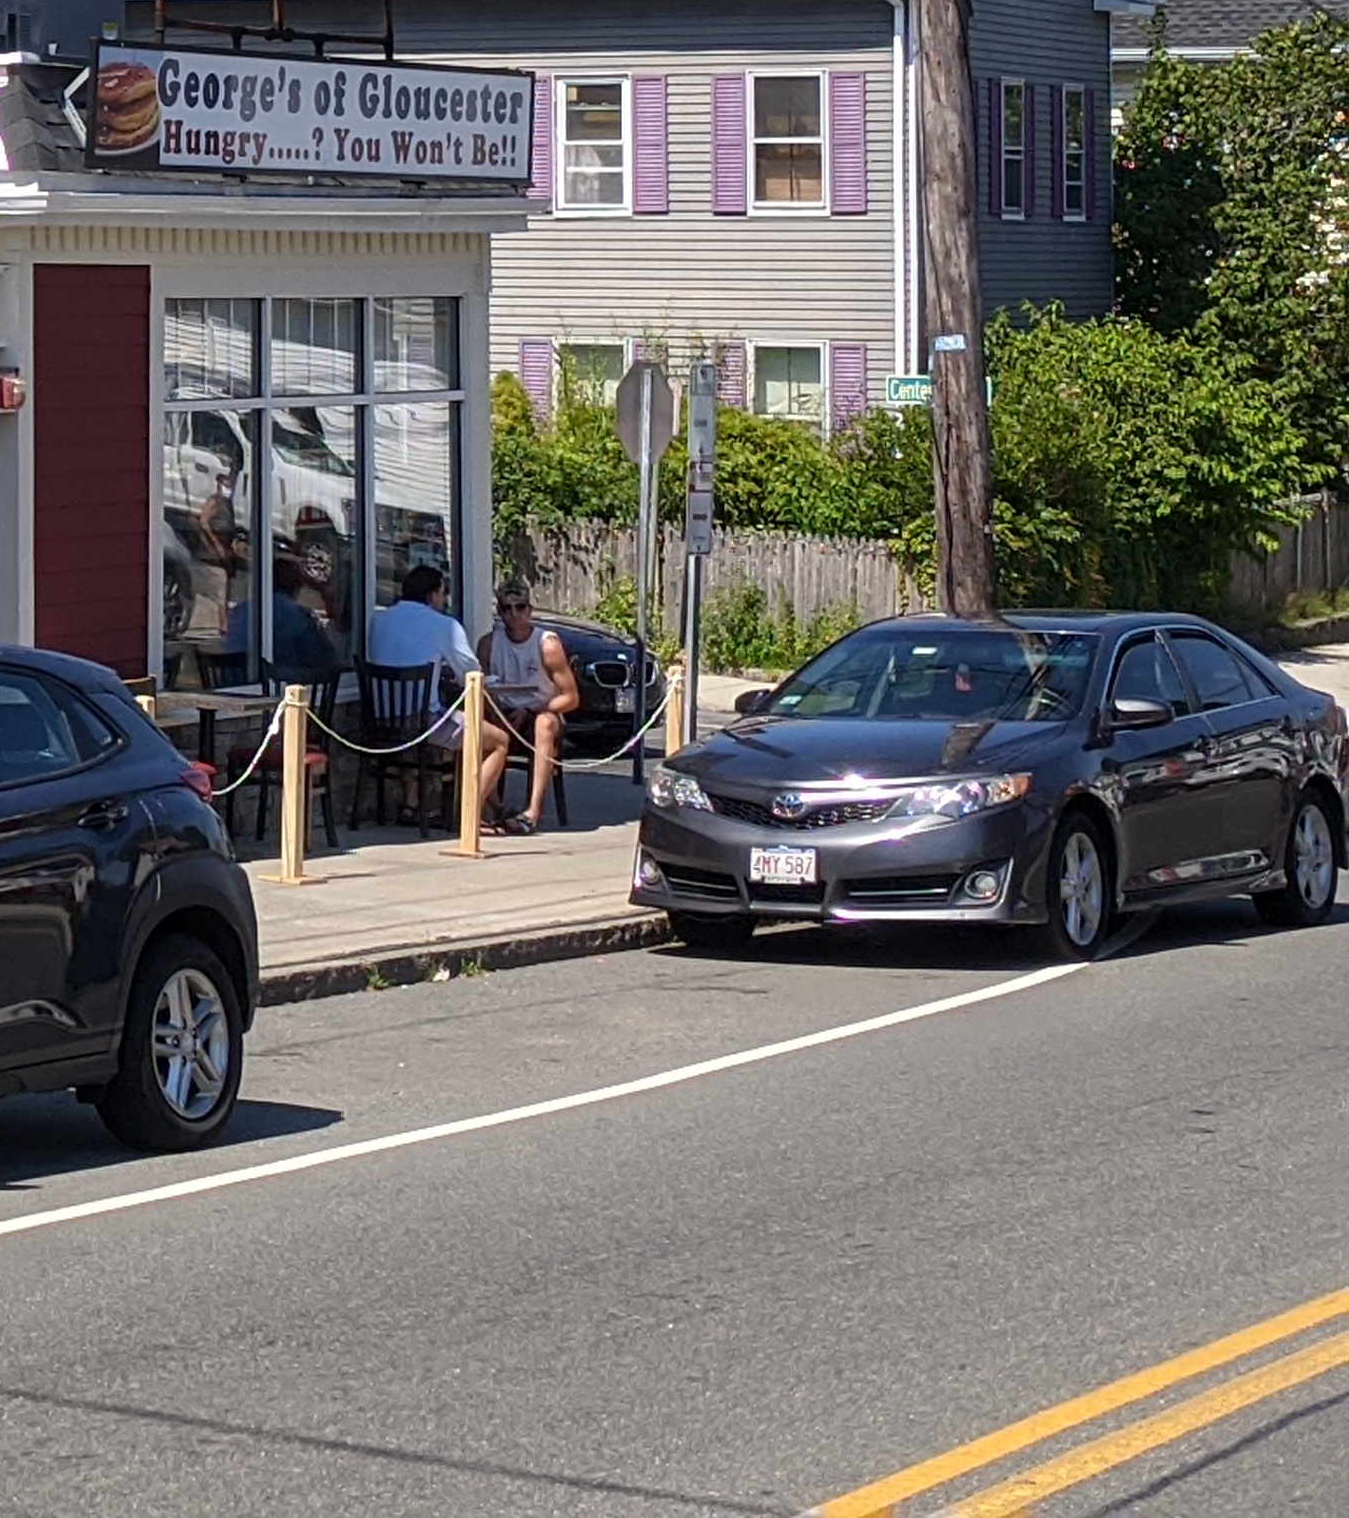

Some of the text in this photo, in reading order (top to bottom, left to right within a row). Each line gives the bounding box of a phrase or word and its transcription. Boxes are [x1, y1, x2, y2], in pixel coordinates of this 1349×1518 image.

[158, 58, 524, 125] George's of Gloucester
[333, 128, 381, 162] You
[391, 130, 463, 166] Won't
[471, 133, 517, 168] Be!!
